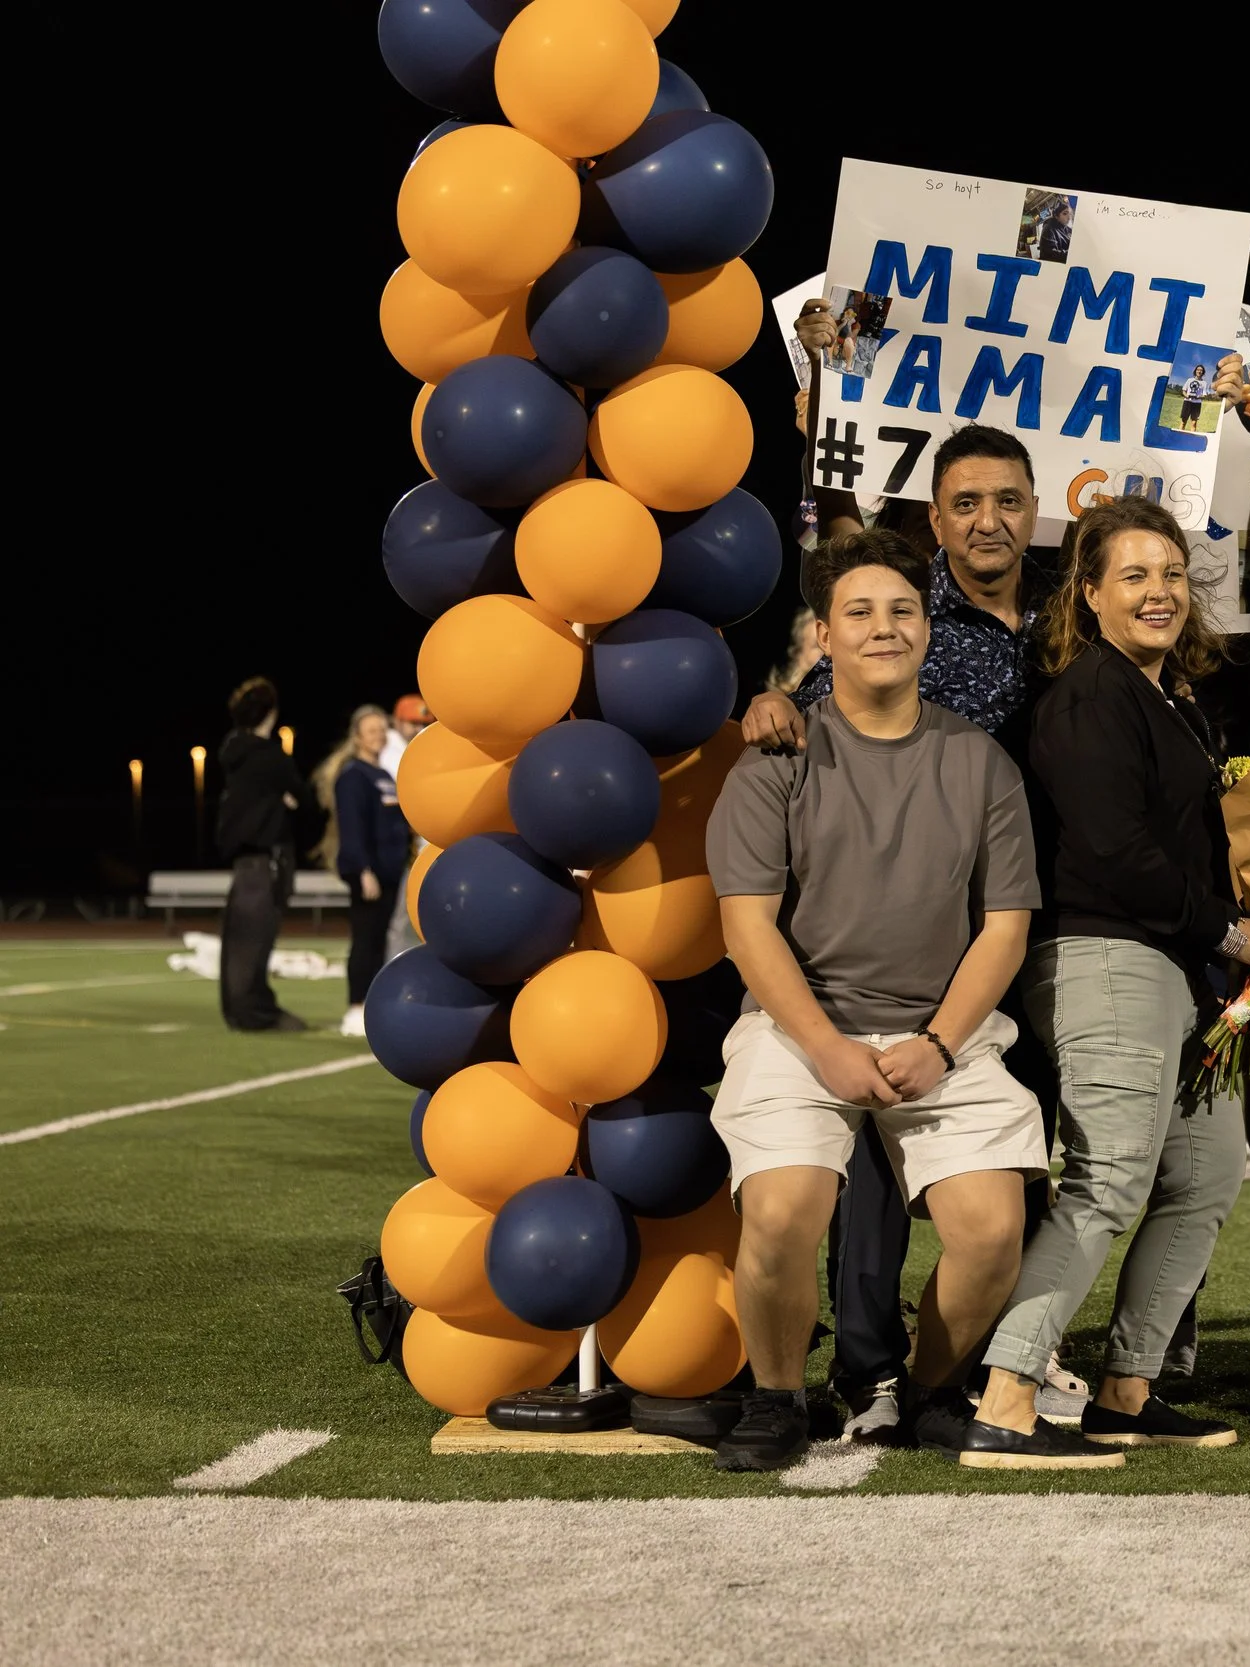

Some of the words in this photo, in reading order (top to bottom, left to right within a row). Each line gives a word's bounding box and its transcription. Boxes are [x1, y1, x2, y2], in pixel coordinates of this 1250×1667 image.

[954, 180, 981, 199] hoyt
[864, 239, 1206, 364] MIMI
[816, 416, 932, 495] #7
